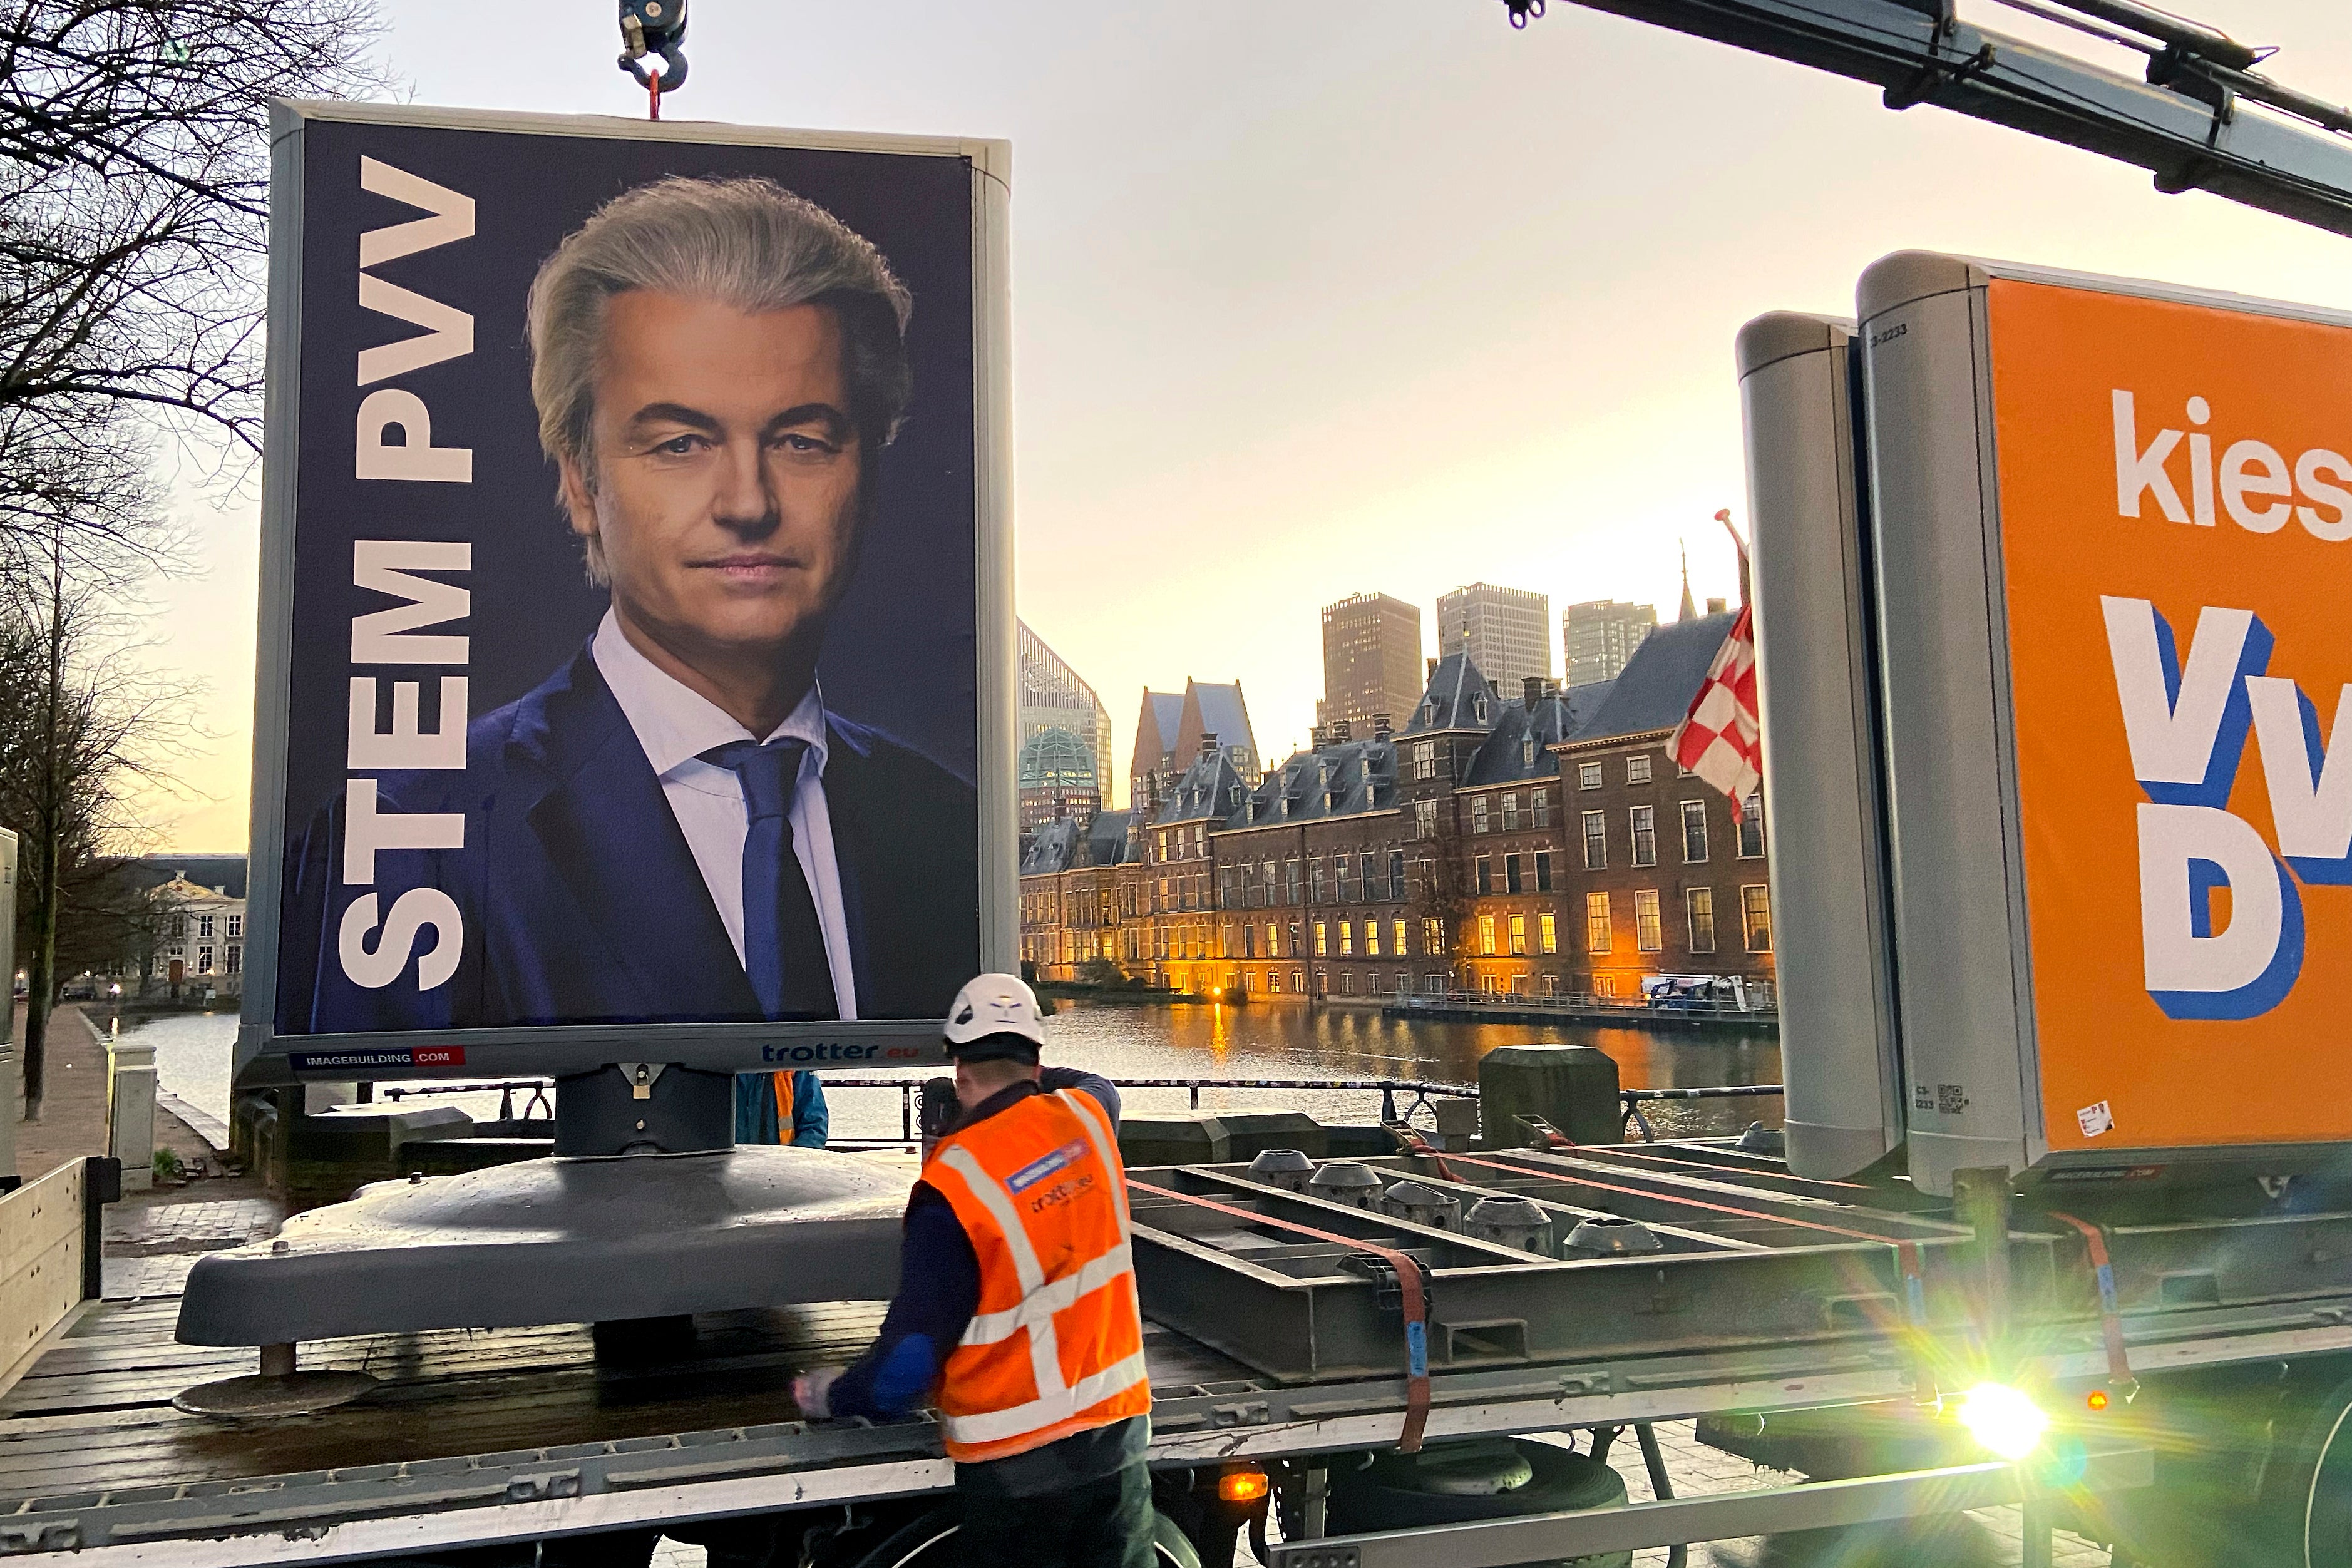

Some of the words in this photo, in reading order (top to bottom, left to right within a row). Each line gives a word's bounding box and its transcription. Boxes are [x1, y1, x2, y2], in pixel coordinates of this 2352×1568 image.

[356, 155, 475, 483] PVV
[1870, 323, 1908, 348] 3-2233
[2112, 389, 2352, 541] kies
[339, 540, 471, 991] STEM
